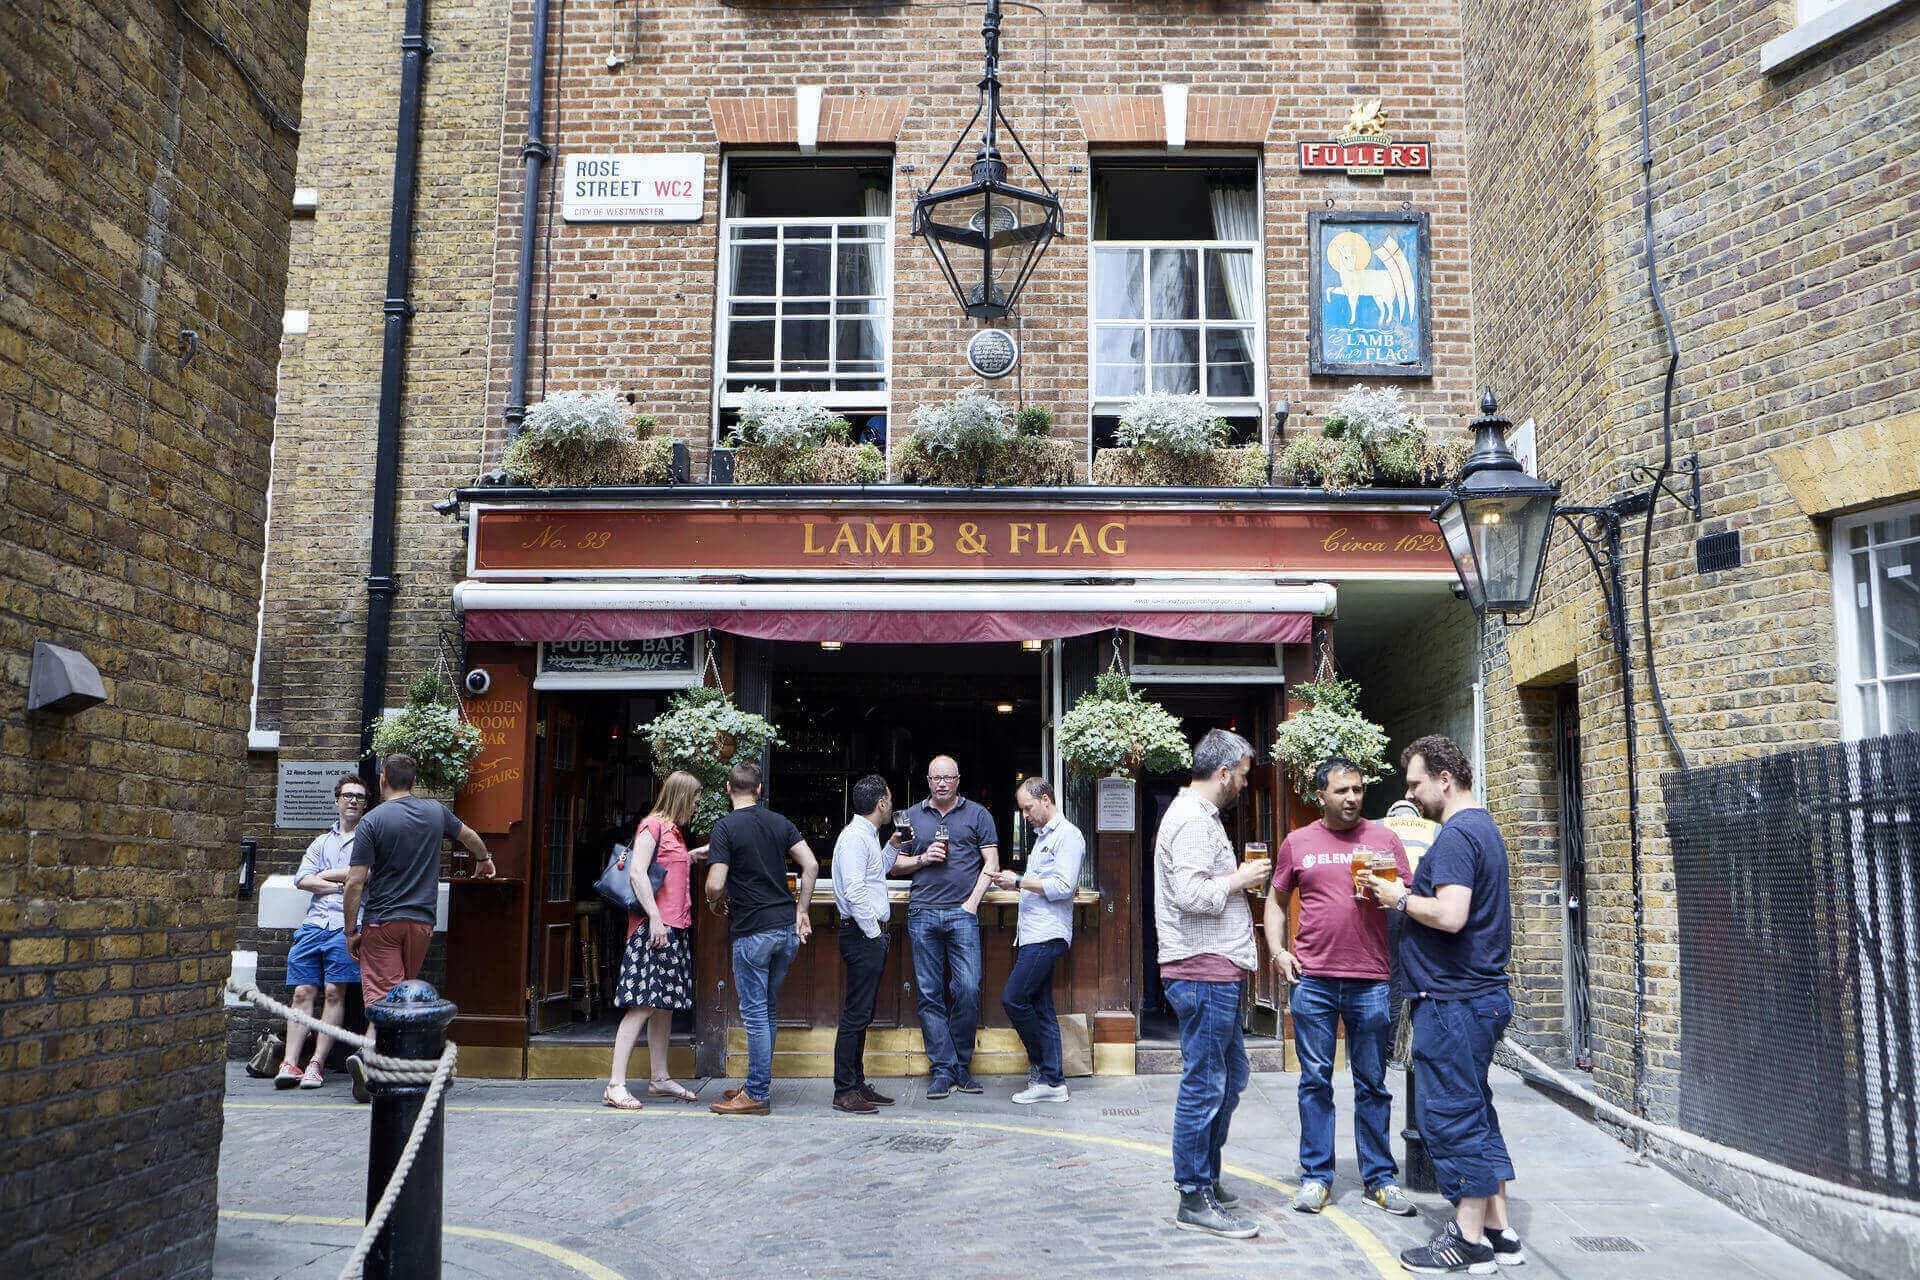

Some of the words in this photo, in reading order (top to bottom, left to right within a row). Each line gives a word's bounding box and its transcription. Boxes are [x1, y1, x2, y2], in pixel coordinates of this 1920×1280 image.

[1308, 144, 1421, 167] FULLER'S
[576, 160, 621, 177] ROSE
[576, 180, 642, 197] STREET
[654, 180, 693, 197] WC2
[574, 207, 591, 216] CITY
[606, 207, 665, 216] WESTMINSTER
[1346, 333, 1394, 347] LAMB
[1365, 347, 1409, 361] FLAG
[521, 524, 568, 549] No.
[577, 531, 612, 549] 33
[802, 522, 935, 555] LAMB
[955, 521, 989, 555] &
[1008, 522, 1127, 555] FLAG
[1320, 527, 1388, 552] Circa
[551, 639, 630, 653] PUBLIC
[642, 636, 686, 652] BAR
[465, 700, 523, 713] DRYDEN
[471, 716, 516, 729] ROOM
[1317, 853, 1354, 865] ELEM
